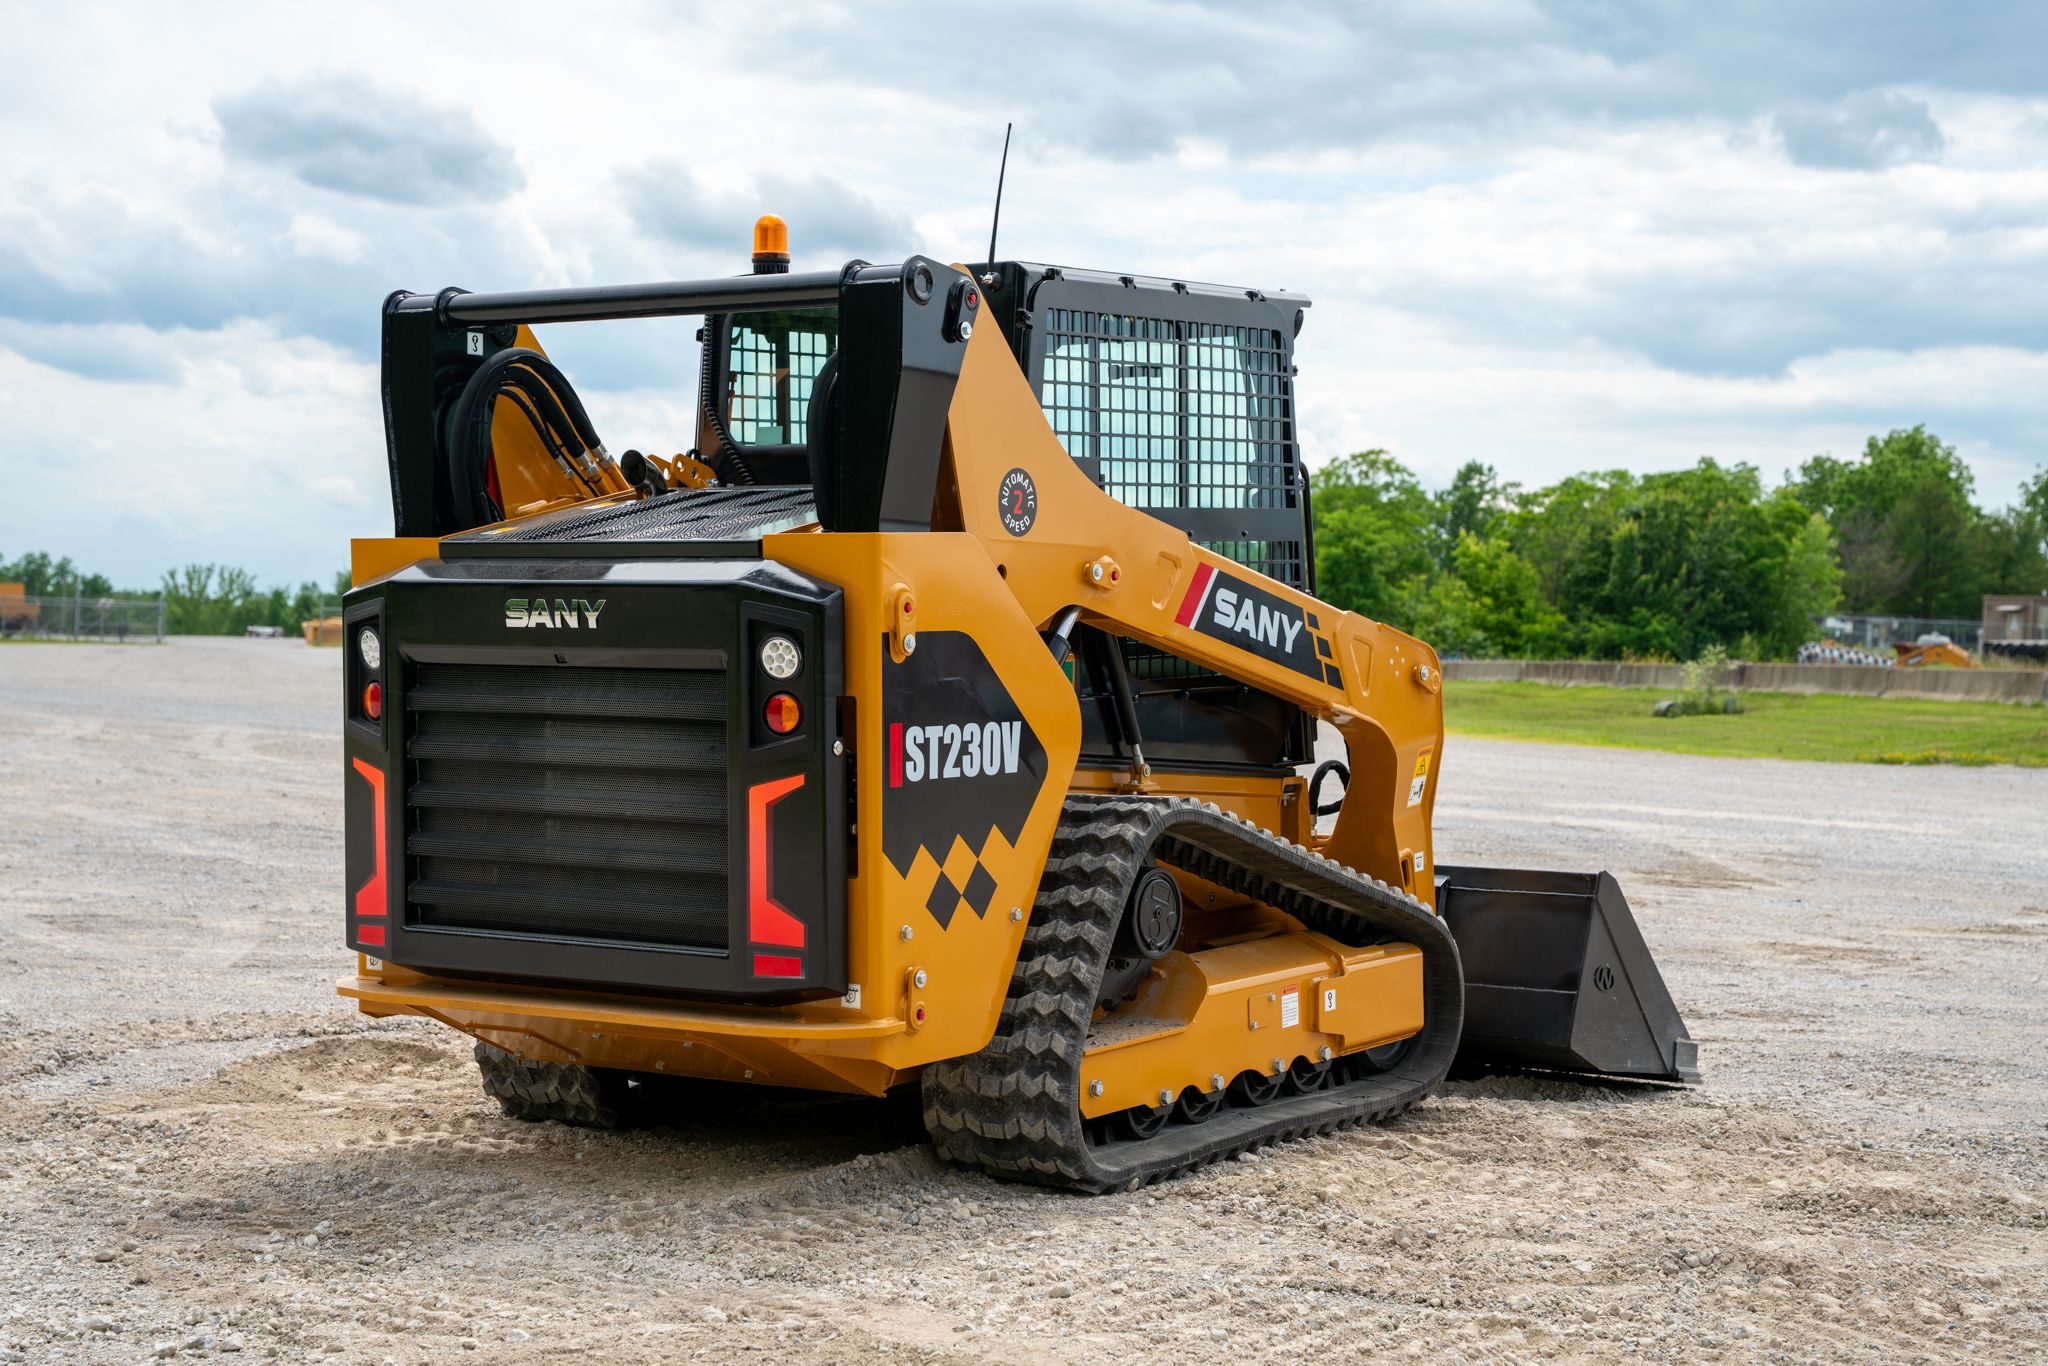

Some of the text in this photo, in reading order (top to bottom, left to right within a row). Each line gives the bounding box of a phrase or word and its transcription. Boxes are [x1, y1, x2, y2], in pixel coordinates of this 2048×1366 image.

[1002, 472, 1035, 508] AUTOMATIC
[1013, 489, 1023, 514] 2
[1004, 513, 1030, 532] SPEED
[505, 598, 607, 629] SANY
[1213, 587, 1304, 654] SANY
[905, 720, 1022, 782] ST230V
